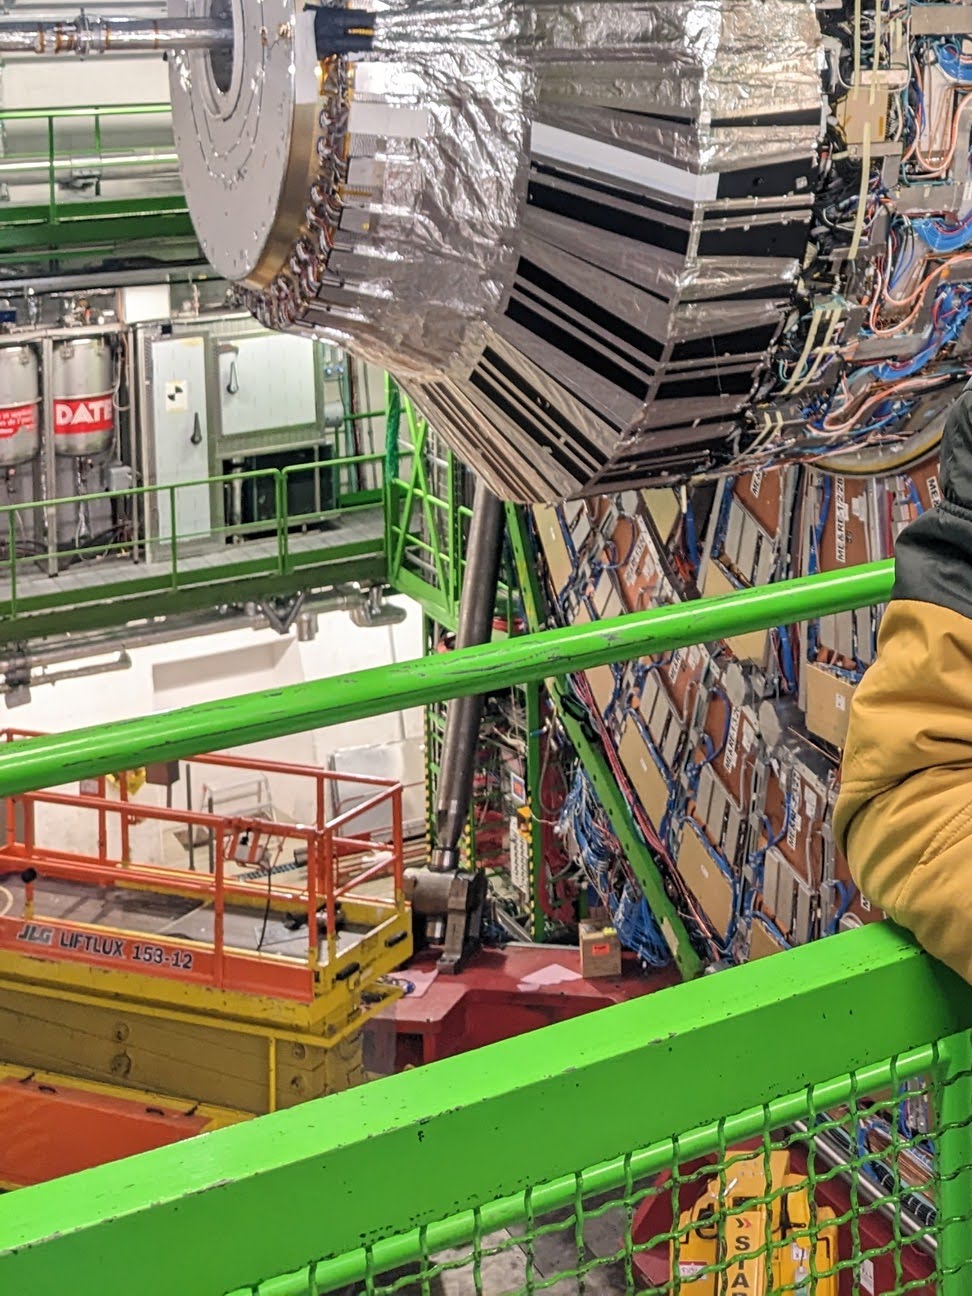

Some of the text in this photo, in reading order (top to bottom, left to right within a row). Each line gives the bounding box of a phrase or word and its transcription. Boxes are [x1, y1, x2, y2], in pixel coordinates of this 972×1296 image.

[18, 924, 193, 970] JLG LIFTLUX 153-12
